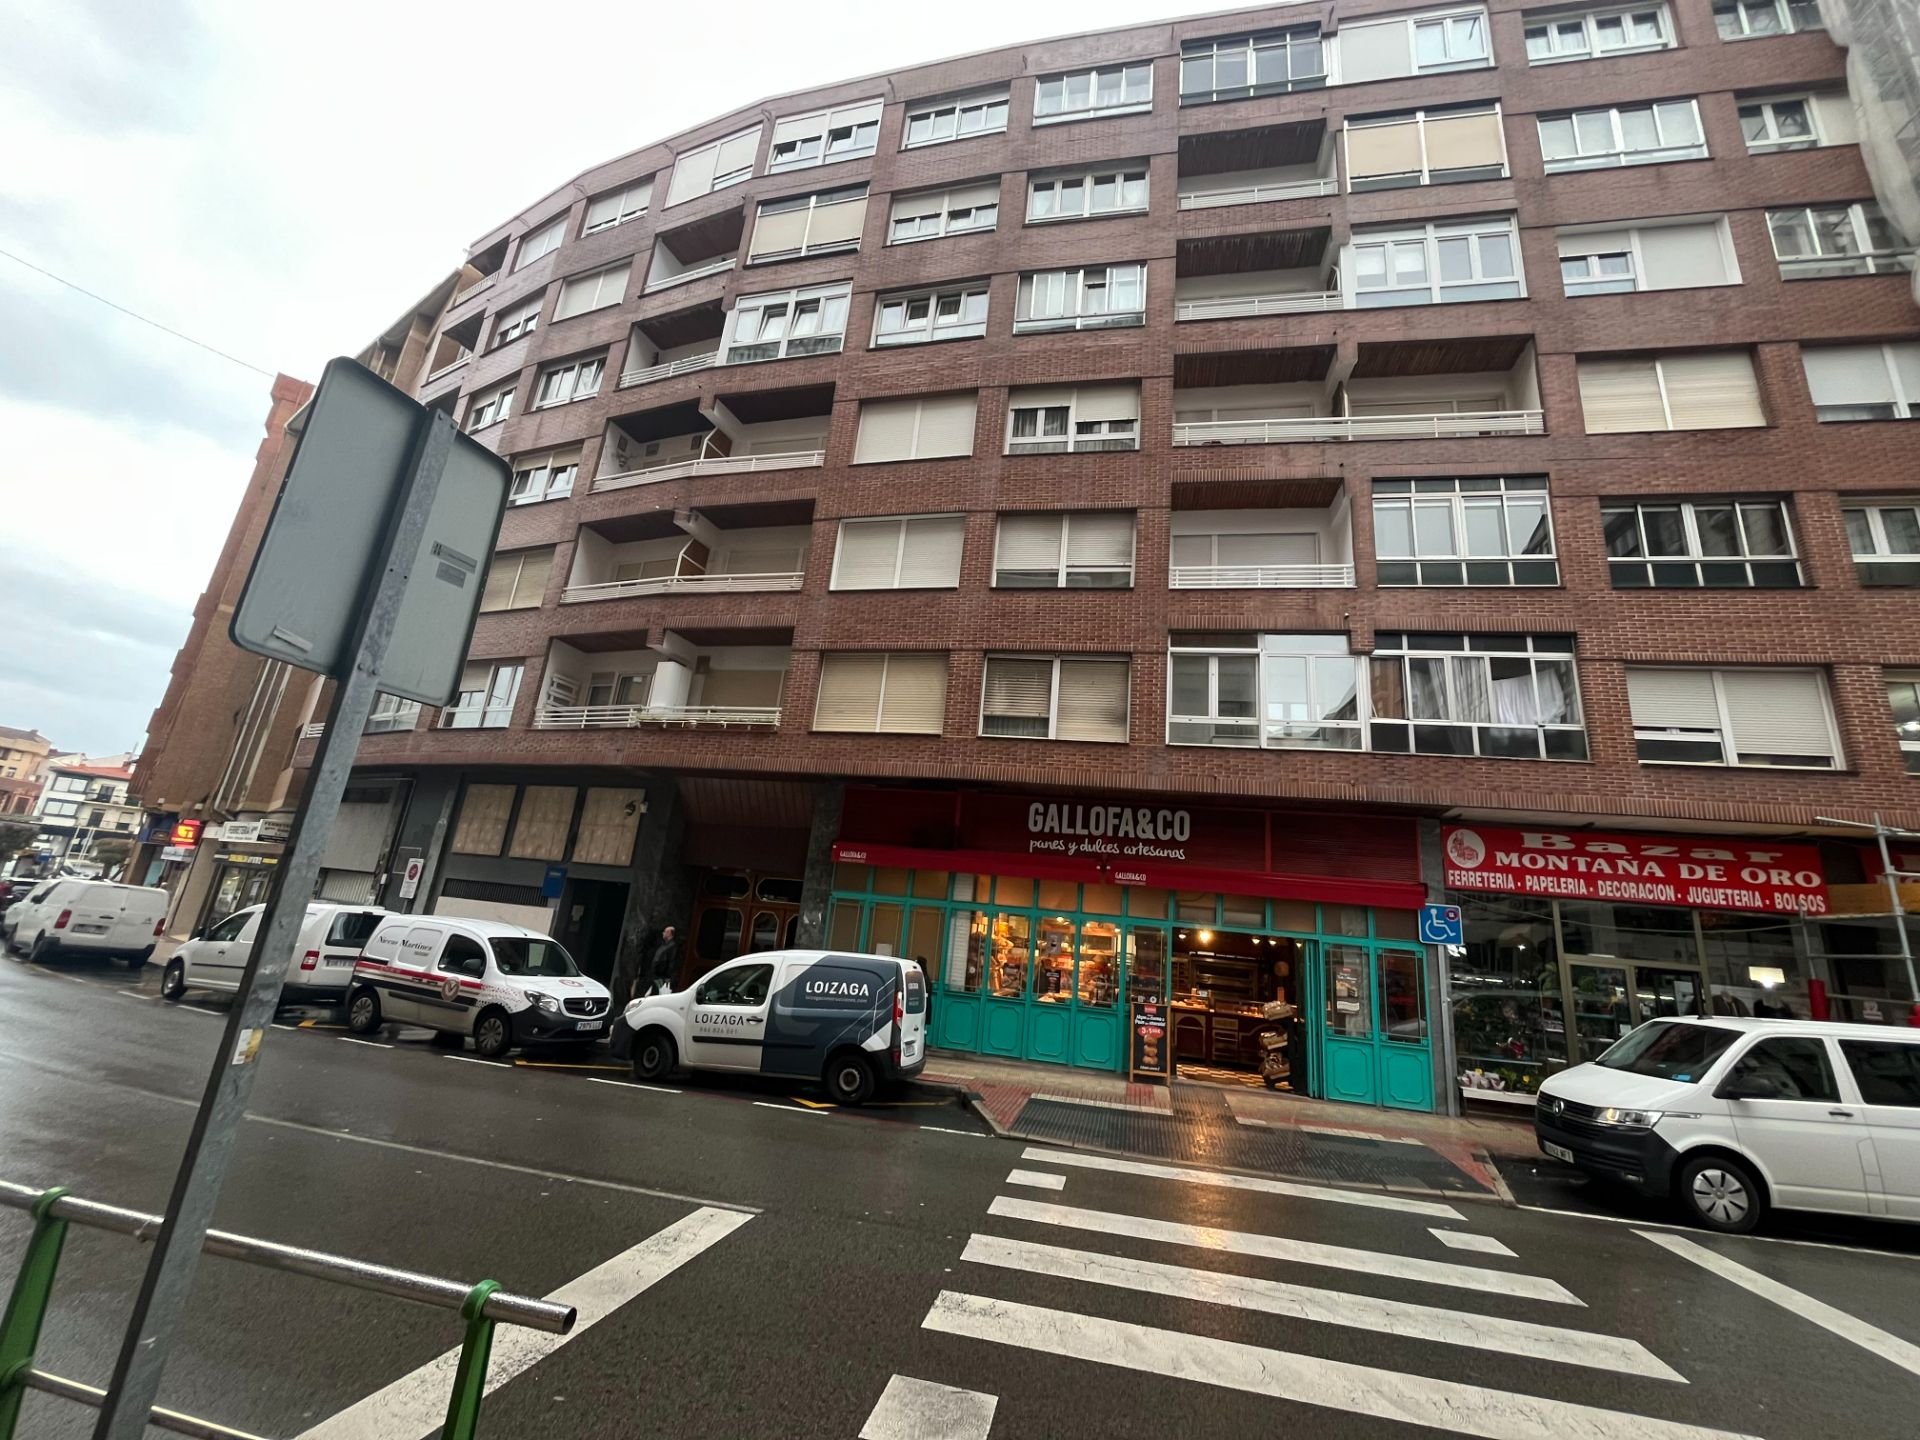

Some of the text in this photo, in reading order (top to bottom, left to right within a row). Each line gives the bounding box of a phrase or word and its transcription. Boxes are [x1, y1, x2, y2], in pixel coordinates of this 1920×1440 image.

[1027, 802, 1191, 842] GALLOFA&CO
[1029, 838, 1186, 860] panes y dulces artesanos
[1520, 831, 1784, 864] Bazar
[1494, 851, 1822, 888] MONTAÑA DE ORO
[1447, 869, 1827, 913] FERRETERIA PAPELERIA DECORACION JUGUETERIA BOLSOS
[805, 980, 870, 997] LOIZAGA
[694, 1013, 745, 1026] LOIZAGA
